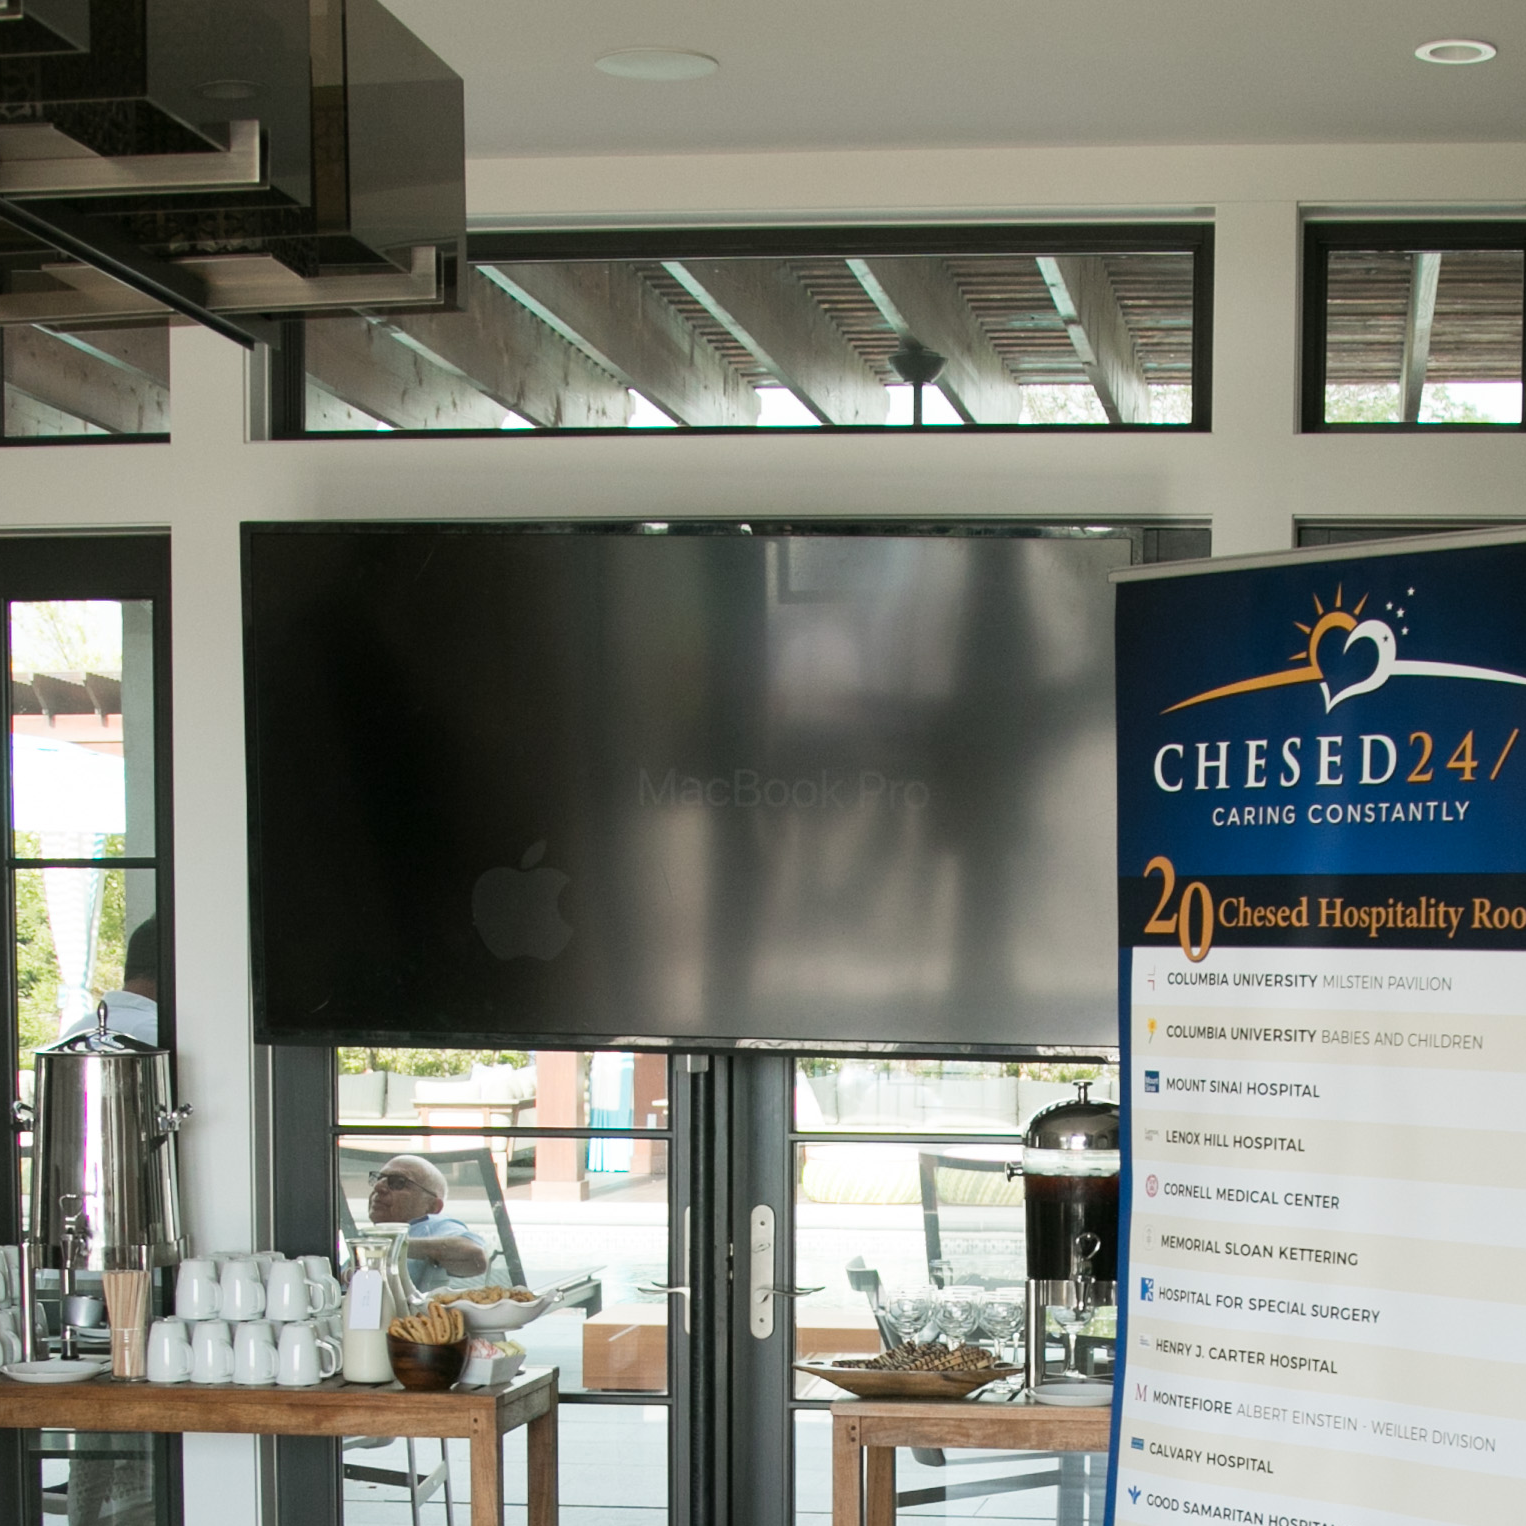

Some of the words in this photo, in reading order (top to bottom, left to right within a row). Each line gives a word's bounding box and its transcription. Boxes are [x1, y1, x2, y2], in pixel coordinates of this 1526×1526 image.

[638, 767, 845, 808] MacBook
[859, 769, 930, 810] Pro
[1212, 805, 1295, 826] CARING
[1308, 801, 1469, 824] CONSTANTLY
[1144, 856, 1214, 962] 20
[1219, 896, 1309, 927] Chesed
[1318, 896, 1464, 938] Hospitality
[1167, 972, 1229, 986] COLUMBIA
[1233, 974, 1318, 987] UNIVERSITY
[1323, 975, 1383, 989] MILSTEIN
[1388, 976, 1452, 991] PAVILION
[1166, 1025, 1227, 1039] COLUMBIA
[1231, 1027, 1316, 1042] UNIVERSITY
[1322, 1030, 1370, 1045] BABIES
[1374, 1032, 1404, 1047] AND
[1408, 1033, 1483, 1050] CHILDREN
[1167, 1078, 1206, 1092] MOUNT
[1210, 1080, 1242, 1094] SINAI
[1247, 1082, 1320, 1098] HOSPITAL
[1166, 1130, 1200, 1145] LENOX
[1204, 1133, 1229, 1148] HILL
[1233, 1136, 1305, 1152] HOSPITAL
[1164, 1182, 1212, 1200] CORNELL
[1216, 1188, 1279, 1205] MEDICAL
[1284, 1193, 1339, 1209] CENTER
[1161, 1235, 1221, 1254] MEMORIAL
[1225, 1242, 1273, 1258] SLOAN
[1279, 1247, 1358, 1266] KETTERING
[1159, 1287, 1211, 1306] HOSPITAL
[1216, 1294, 1243, 1309] FOR
[1248, 1298, 1306, 1316] SPECIAL
[1311, 1304, 1380, 1323] SURGERY
[1156, 1339, 1192, 1356] HENRY
[1195, 1345, 1204, 1359] J.
[1209, 1347, 1265, 1365] CARTER
[1270, 1354, 1338, 1374] HOSPITAL
[1153, 1390, 1232, 1414] MONTEFIORE
[1236, 1403, 1288, 1421] ALBERT
[1292, 1410, 1357, 1431] EINSTEIN
[1371, 1421, 1428, 1442] WEILLER
[1432, 1430, 1496, 1452] DIVISION
[1149, 1442, 1202, 1463] CALVARY
[1207, 1452, 1273, 1474] HOSPITAL
[1147, 1493, 1179, 1511] GOOD
[1183, 1501, 1263, 1525] SAMARITAN
